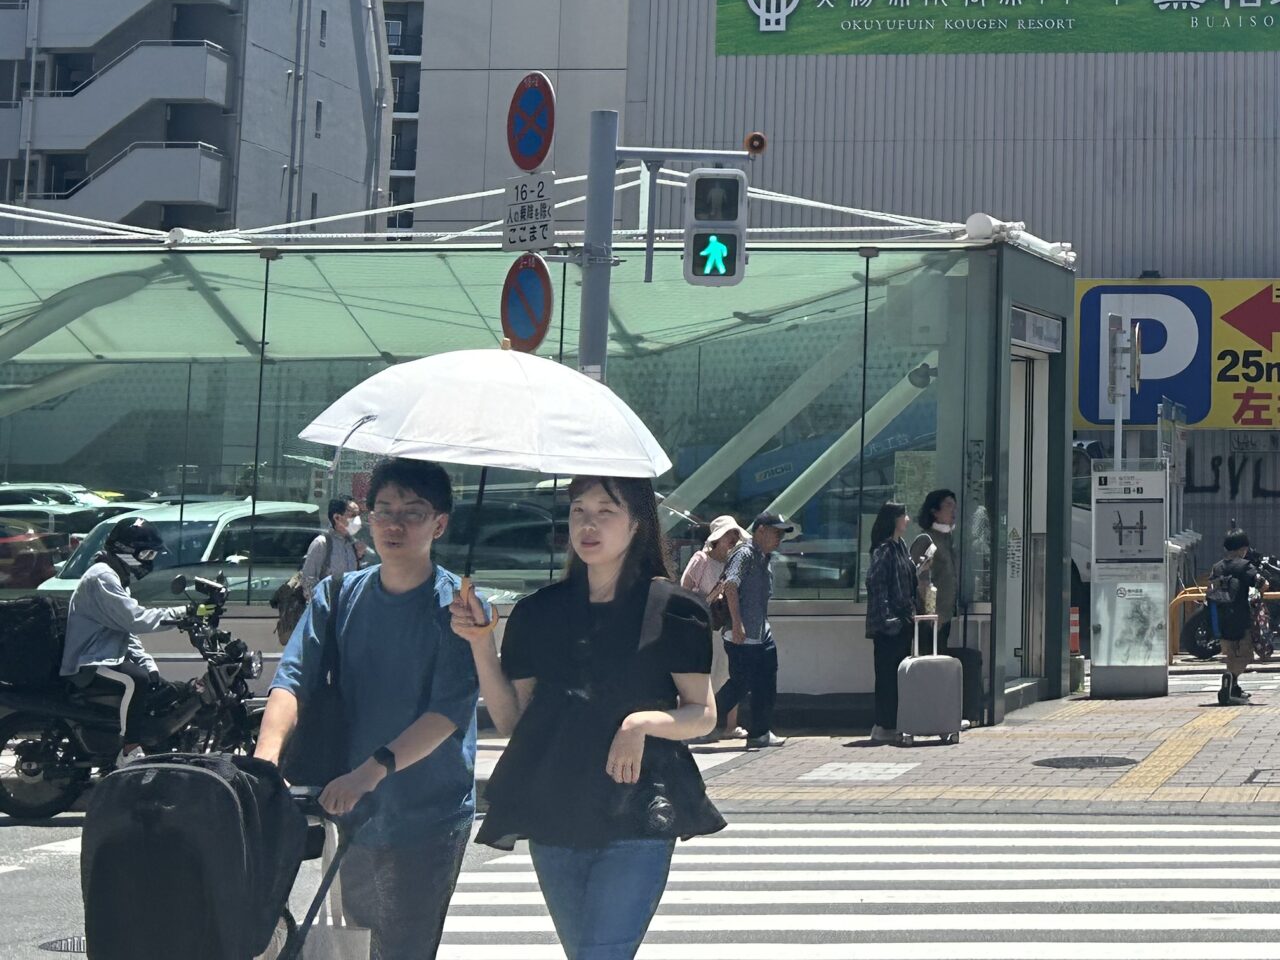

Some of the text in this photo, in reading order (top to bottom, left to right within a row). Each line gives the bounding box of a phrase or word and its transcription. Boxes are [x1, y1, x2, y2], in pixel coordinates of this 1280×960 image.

[841, 18, 1075, 30] OKUYUFUIN KOUGEN RESORT
[1190, 16, 1275, 28] BUAISO
[515, 181, 545, 202] 16-2
[508, 223, 549, 245] ここまで
[1099, 293, 1199, 420] P
